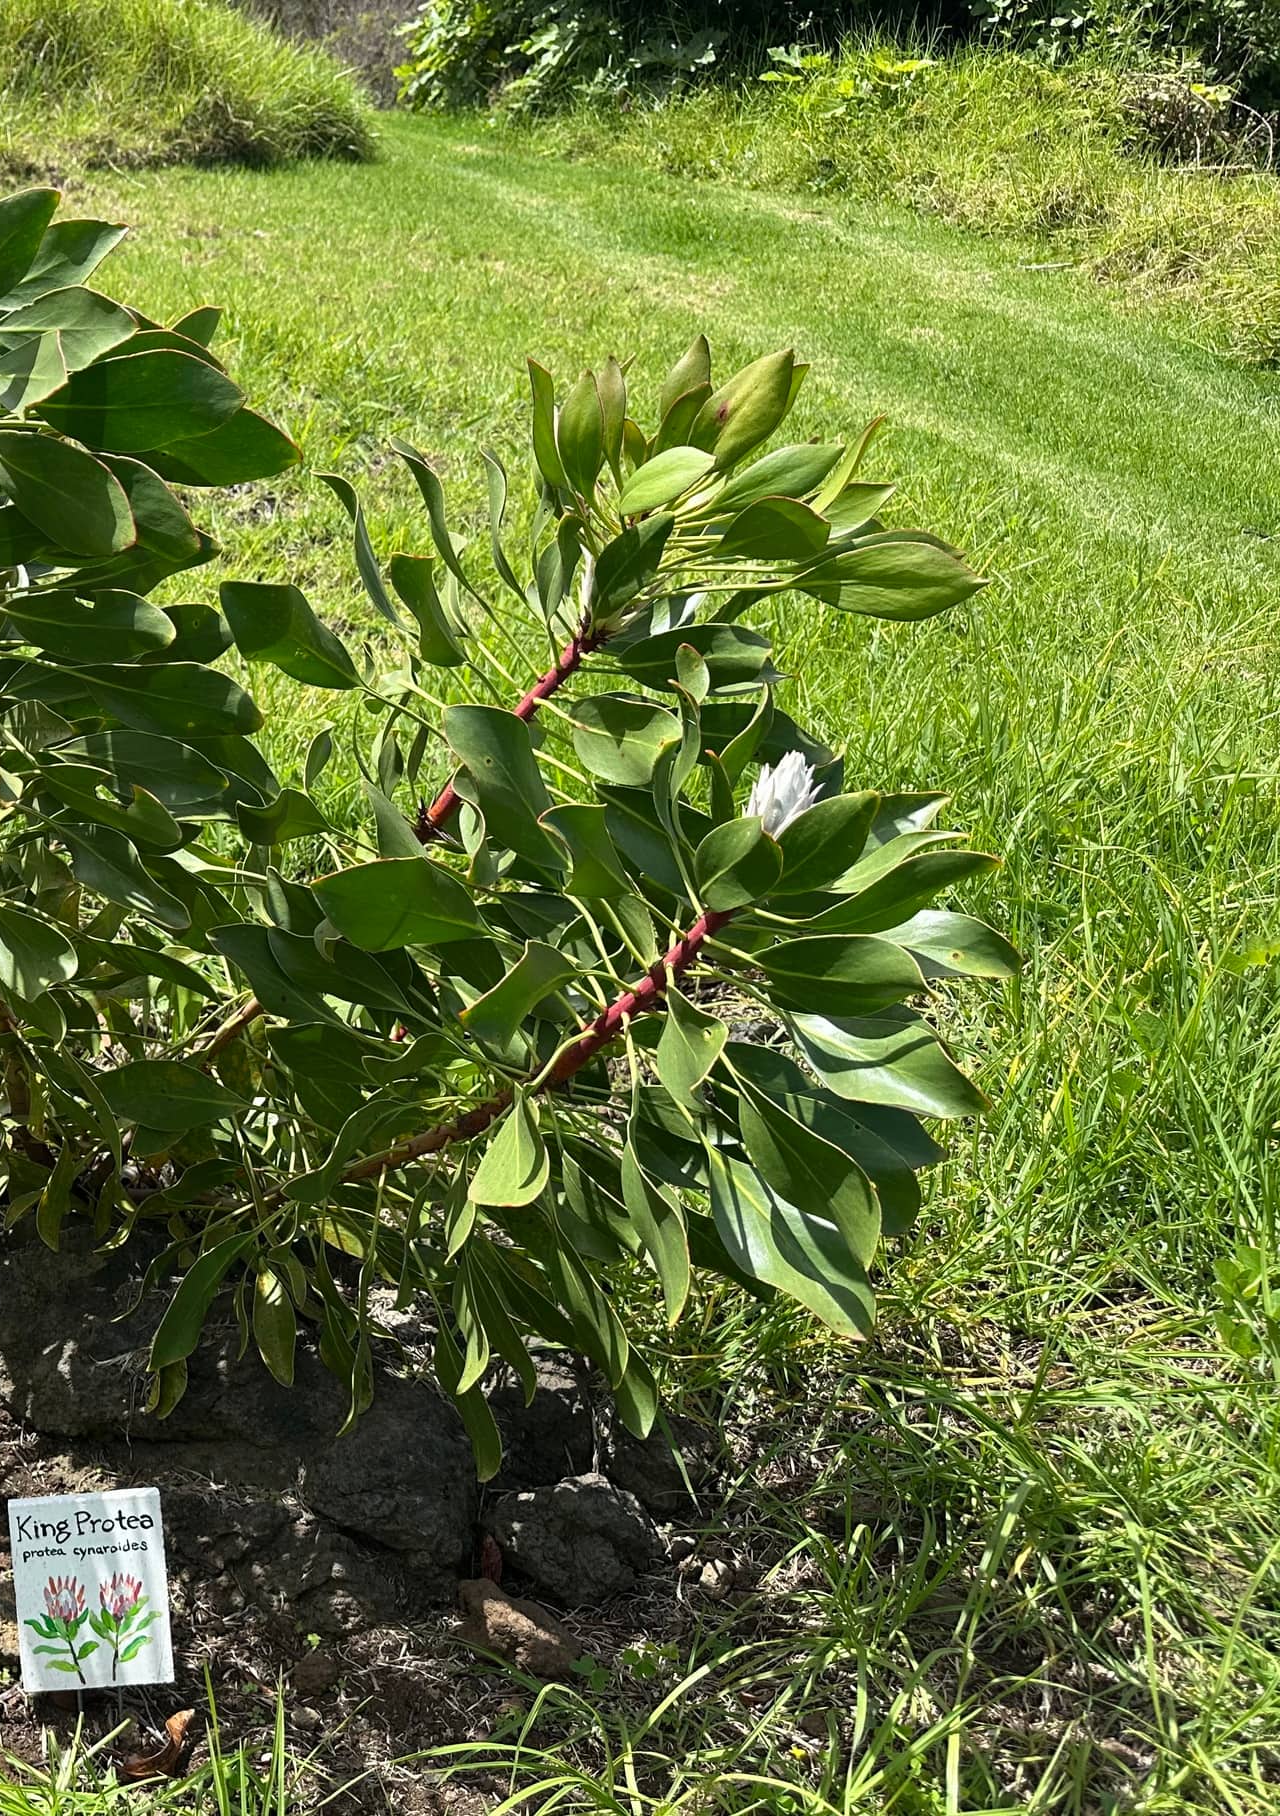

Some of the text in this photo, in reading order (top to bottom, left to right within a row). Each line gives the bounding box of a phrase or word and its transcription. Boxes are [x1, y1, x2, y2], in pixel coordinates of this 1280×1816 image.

[16, 1509, 154, 1544] King Protea
[22, 1539, 149, 1563] protea cynaroides
